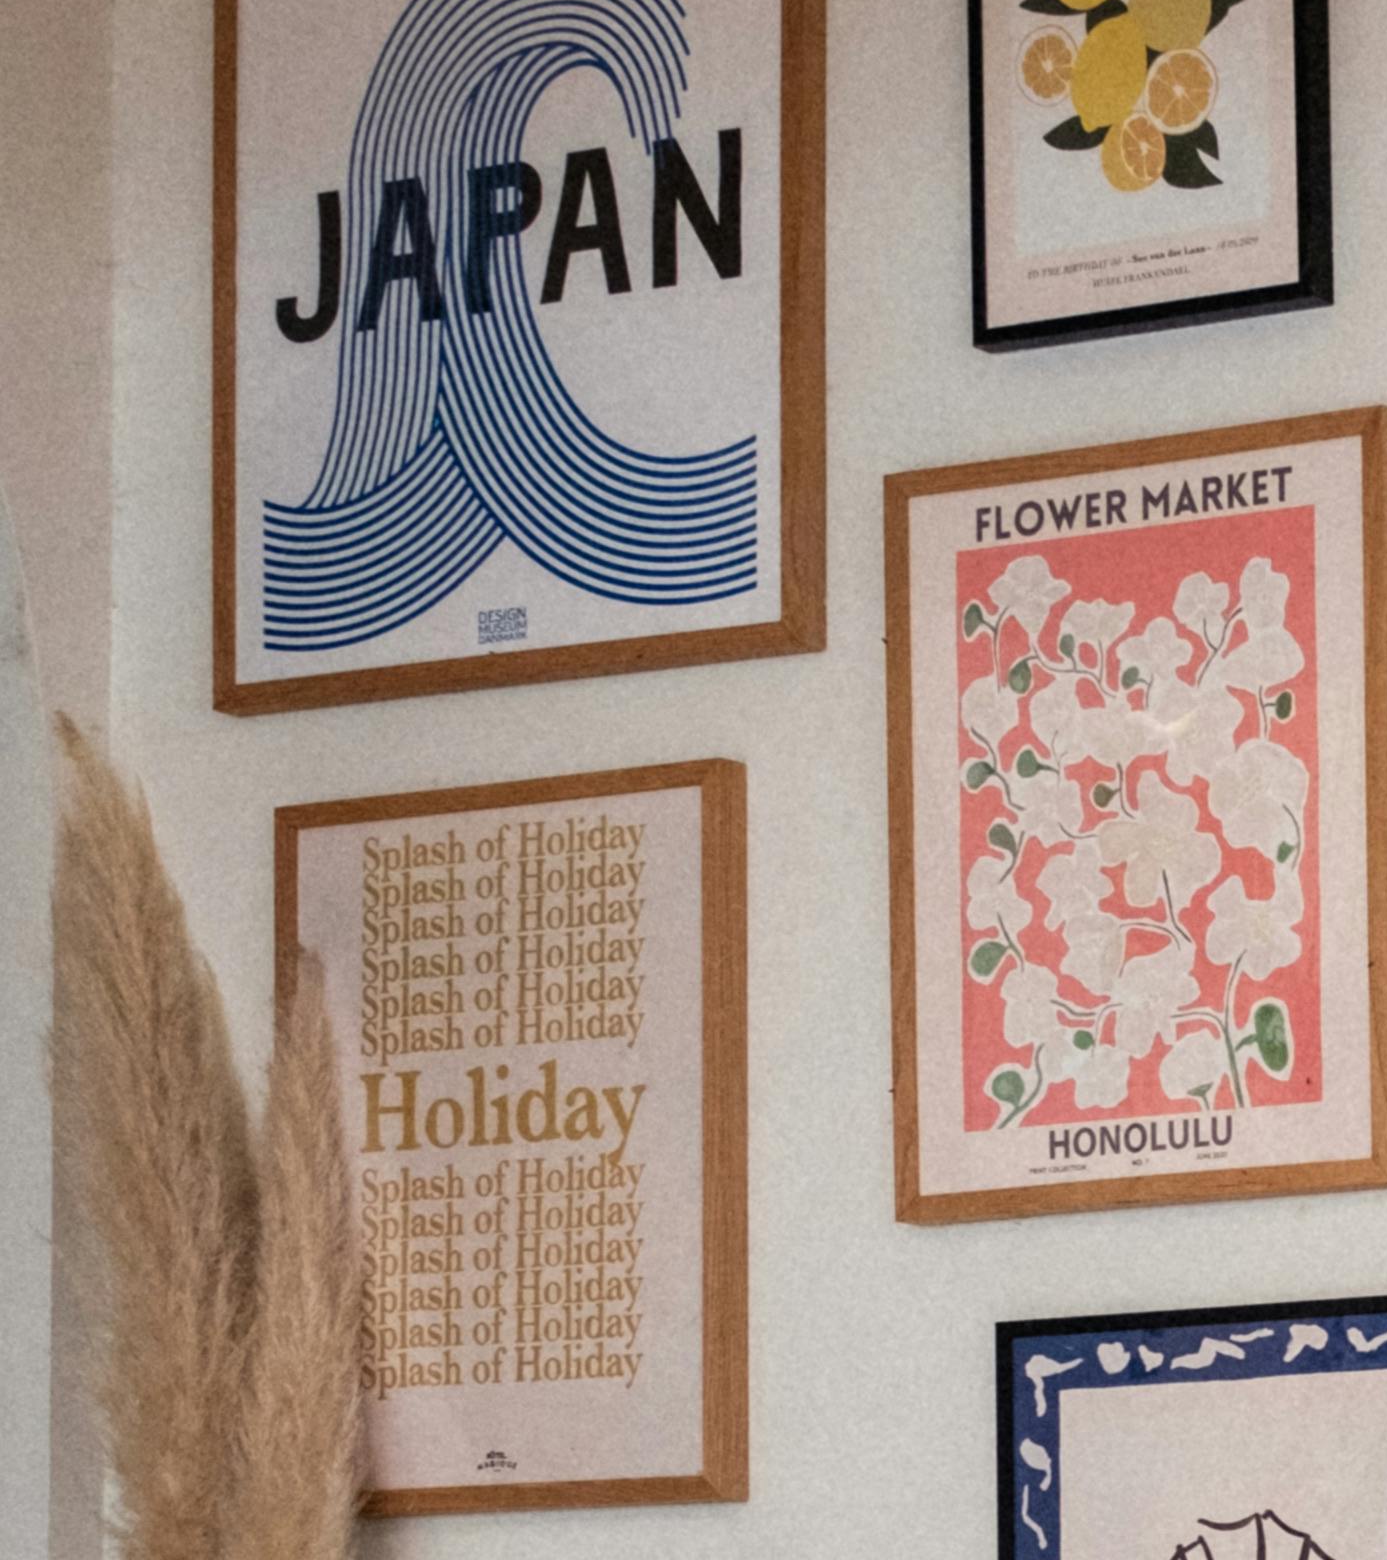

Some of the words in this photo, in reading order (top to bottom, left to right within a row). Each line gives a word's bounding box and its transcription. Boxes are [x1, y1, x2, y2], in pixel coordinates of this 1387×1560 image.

[274, 126, 745, 345] JAPAN
[974, 486, 1127, 544] FLOWER
[1140, 465, 1293, 520] MARKET
[362, 829, 466, 882] Splash
[475, 824, 511, 862] of
[518, 814, 647, 859] Holiday
[362, 866, 466, 919] Splash
[475, 861, 510, 898] of
[518, 852, 646, 896] Holiday
[362, 904, 465, 956] Splash
[475, 897, 510, 936] of
[518, 890, 645, 935] Holiday
[361, 943, 464, 993] Splash
[474, 936, 510, 974] of
[517, 928, 645, 973] Holiday
[361, 980, 464, 1030] Splash
[474, 973, 509, 1011] of
[517, 965, 645, 1011] Holiday
[360, 1016, 464, 1066] Splash
[474, 1010, 509, 1048] of
[516, 1002, 645, 1048] Holiday
[359, 1058, 646, 1165] Holiday
[1049, 1115, 1233, 1160] HONOLULU
[361, 1163, 464, 1215] Splash
[475, 1160, 510, 1196] of
[517, 1152, 645, 1199] Holiday
[361, 1200, 464, 1252] Splash
[474, 1197, 509, 1235] of
[516, 1190, 645, 1236] Holiday
[359, 1348, 463, 1401] Splash
[472, 1345, 508, 1384] of
[515, 1342, 643, 1389] Holiday
